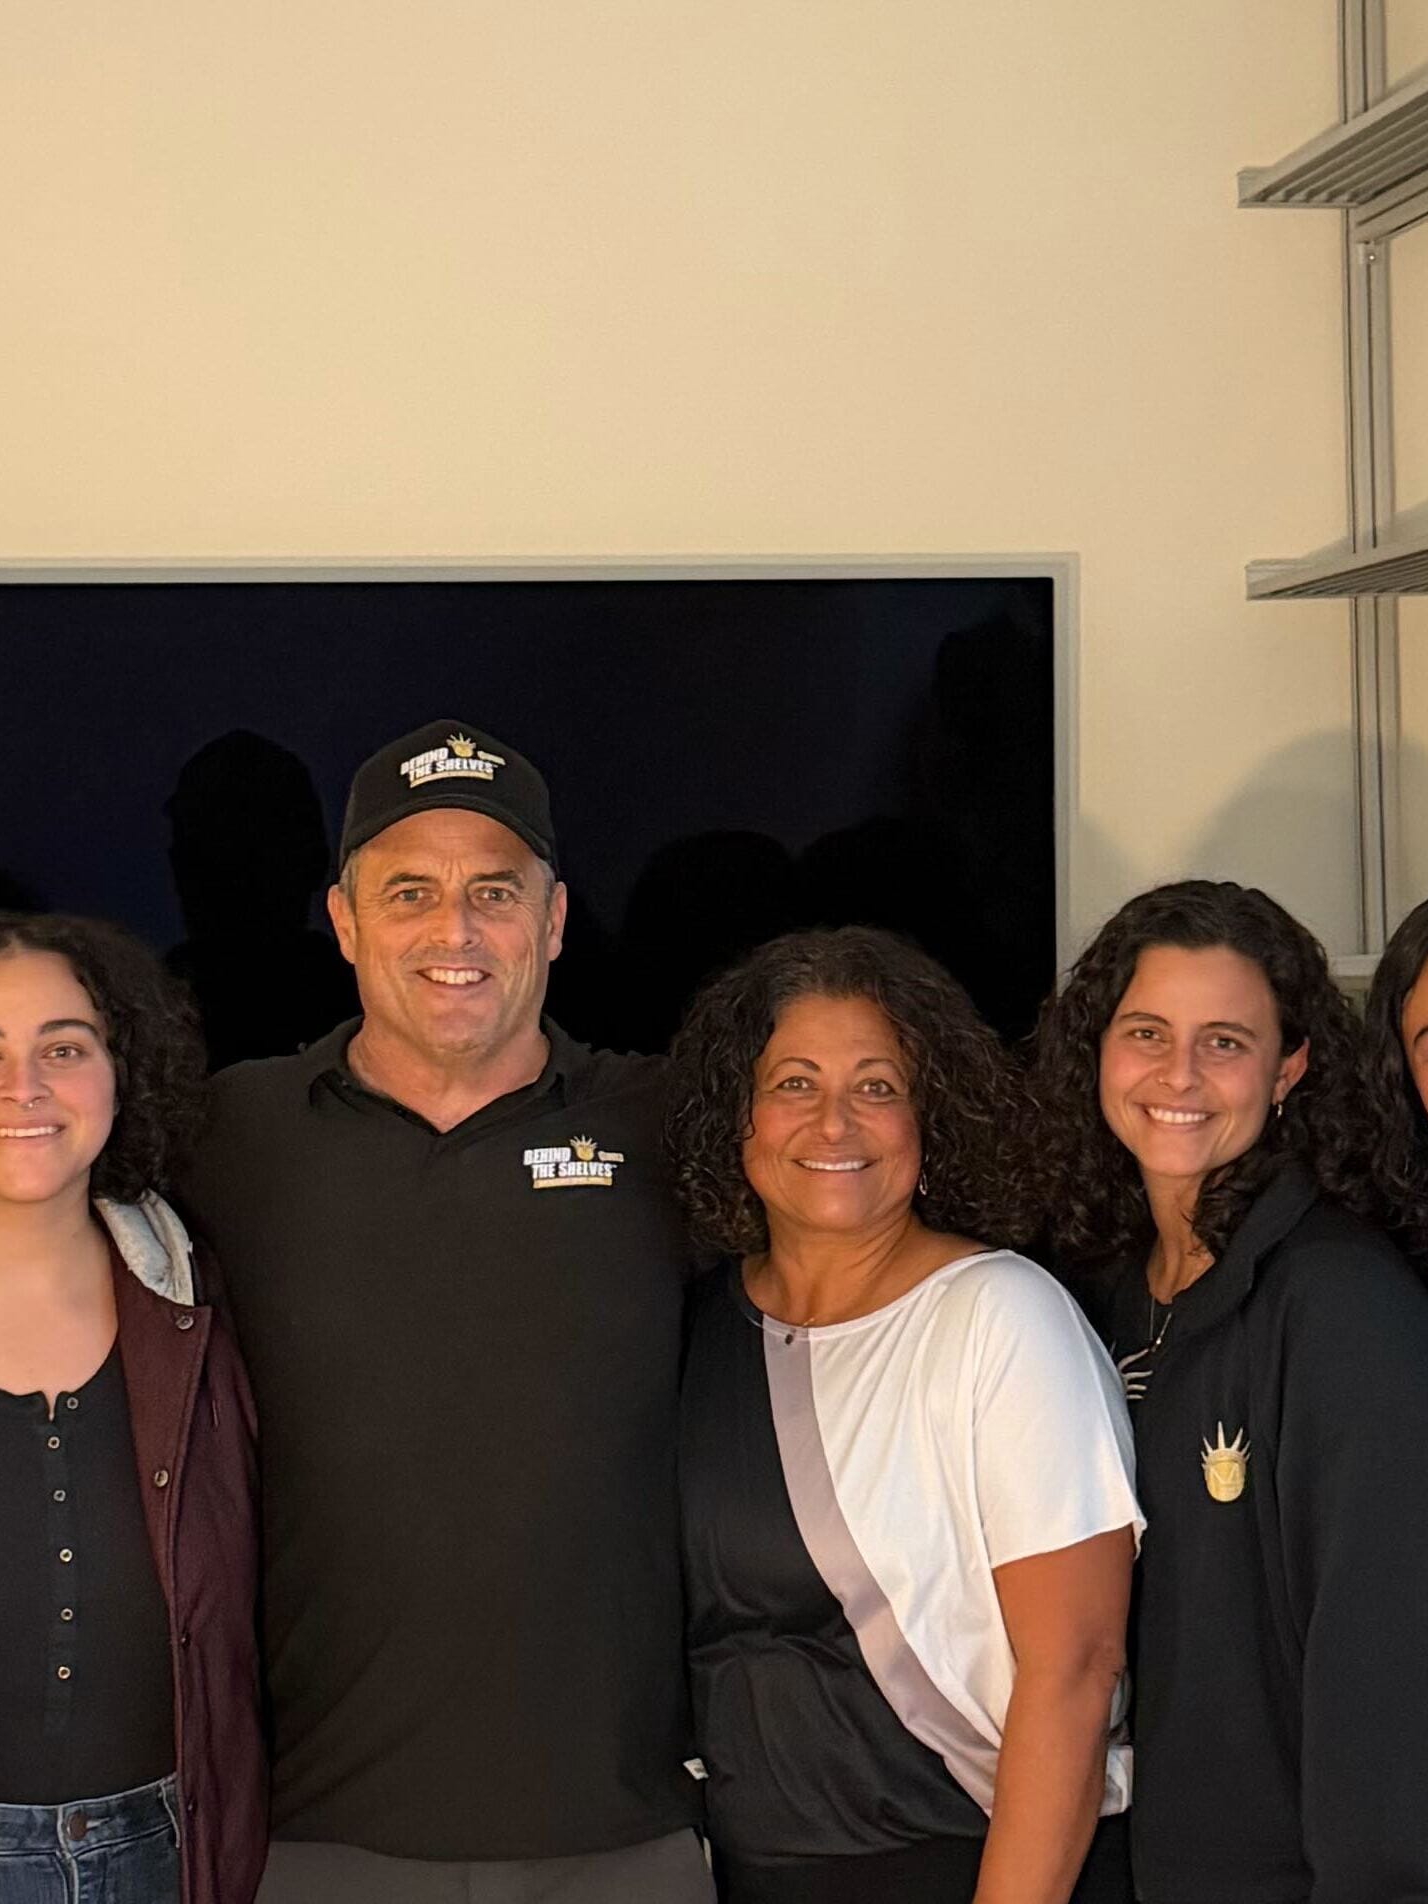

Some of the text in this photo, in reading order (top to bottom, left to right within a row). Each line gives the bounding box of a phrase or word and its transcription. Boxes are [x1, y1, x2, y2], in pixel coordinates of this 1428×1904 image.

[400, 747, 449, 776] BEHIND
[409, 761, 433, 783] THE
[523, 1147, 571, 1166] BEHIND
[532, 1162, 556, 1179] THE
